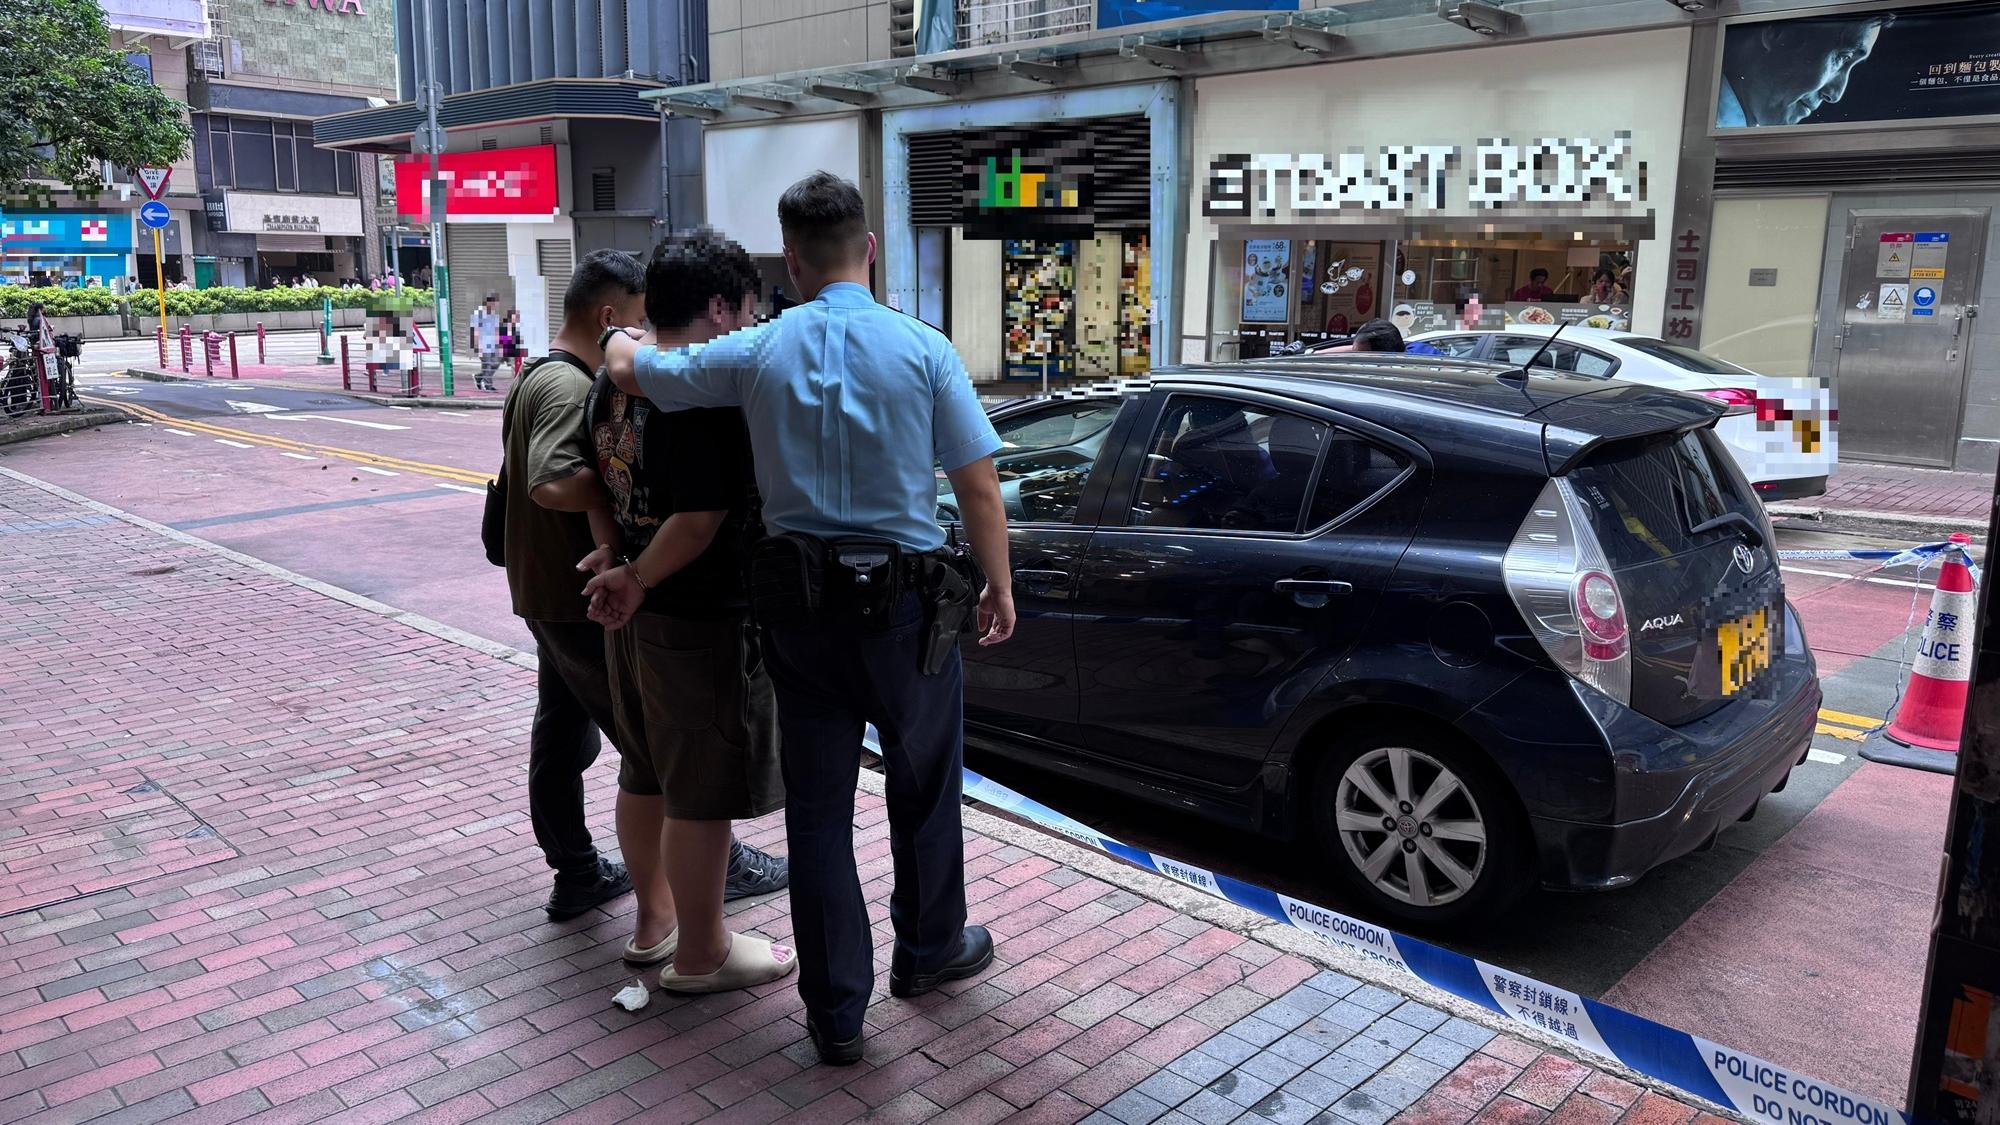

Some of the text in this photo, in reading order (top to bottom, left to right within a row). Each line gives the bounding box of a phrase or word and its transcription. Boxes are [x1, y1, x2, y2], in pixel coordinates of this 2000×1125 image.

[1640, 613, 1684, 632] AQUA
[1918, 636, 1960, 661] LICE
[1289, 902, 1330, 929] POLICE
[1516, 1003, 1580, 1041] 不得越過
[1714, 1050, 1889, 1125] POLICE CORDON
[1752, 1093, 1784, 1121] DO
